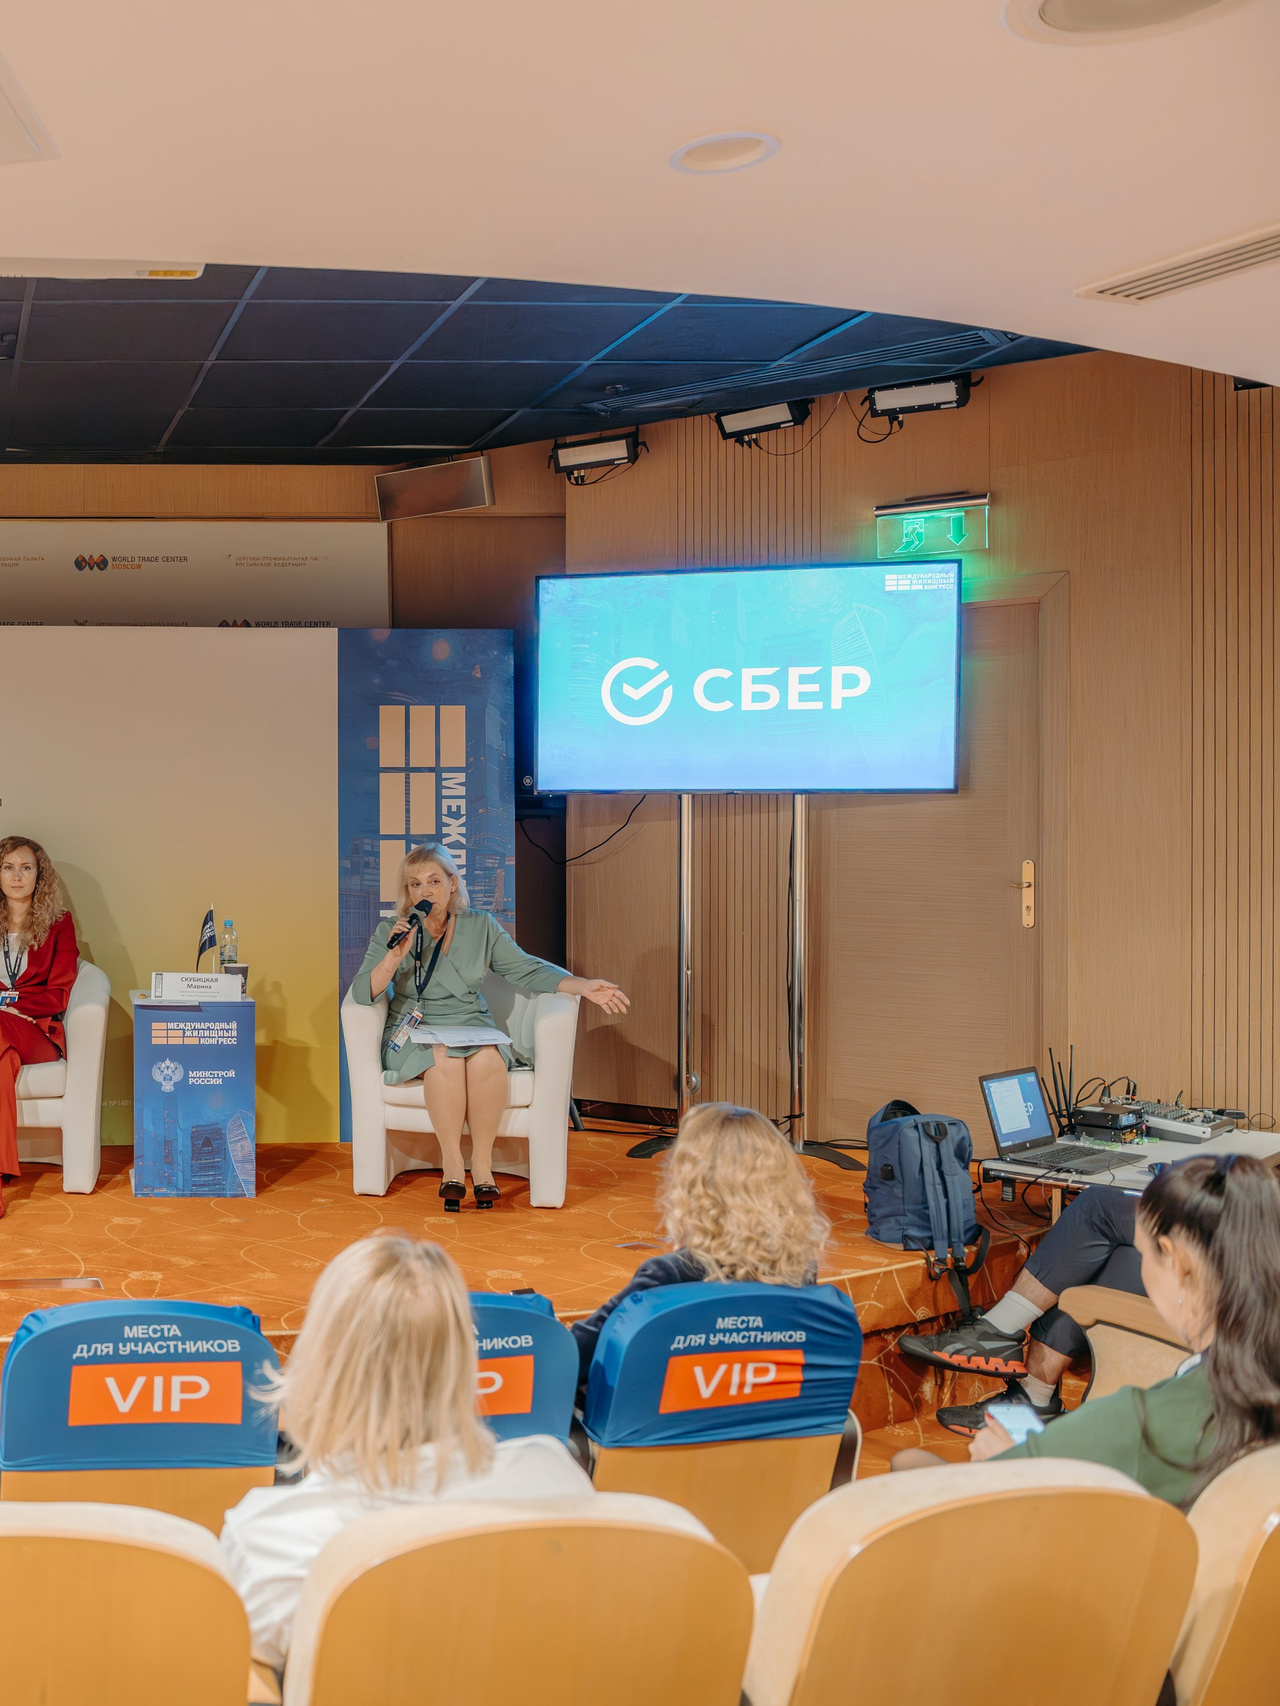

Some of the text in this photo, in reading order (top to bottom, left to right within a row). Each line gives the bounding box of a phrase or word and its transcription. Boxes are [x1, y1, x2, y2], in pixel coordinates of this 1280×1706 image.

[693, 666, 871, 711] СБЕР
[167, 1021, 237, 1030] МЕЖДУНАРОДНЫЙ
[184, 1029, 237, 1038] ЖИЛИЩНЫЙ
[189, 1069, 235, 1078] МИНСТРОЙ
[189, 1077, 222, 1085] РОССИИ
[715, 1316, 764, 1330] МЕСТА
[123, 1324, 182, 1339] МЕСТА
[670, 1330, 807, 1350] ДЛЯ УЧАСТНИКОВ
[72, 1339, 241, 1359] ДЛЯ УЧАСТНИКОВ
[693, 1362, 777, 1399] VIP
[104, 1375, 211, 1413] VIP
